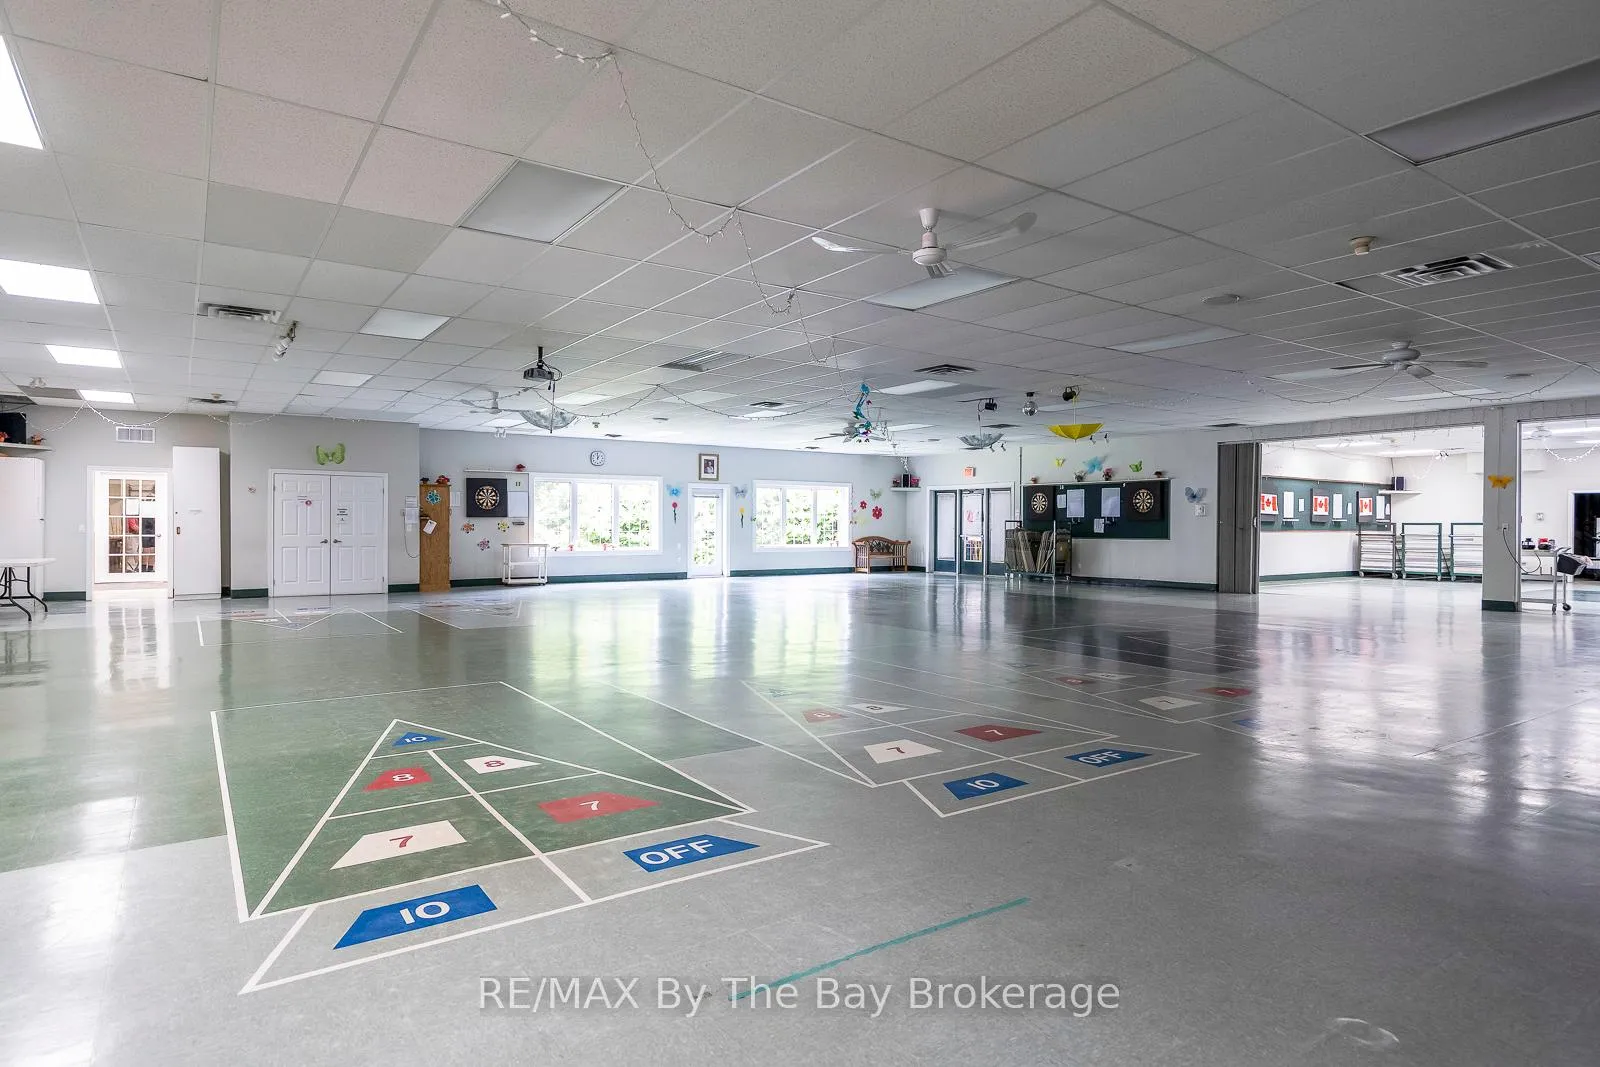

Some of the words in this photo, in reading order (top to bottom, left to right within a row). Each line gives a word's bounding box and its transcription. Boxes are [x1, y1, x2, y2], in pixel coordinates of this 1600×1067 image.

[886, 746, 906, 754] 7
[1078, 751, 1122, 765] OFF
[392, 773, 415, 782] 8
[966, 779, 1001, 790] 10
[578, 800, 601, 811] 7
[389, 835, 414, 848] 7
[639, 839, 715, 865] OFF
[399, 901, 450, 925] 10
